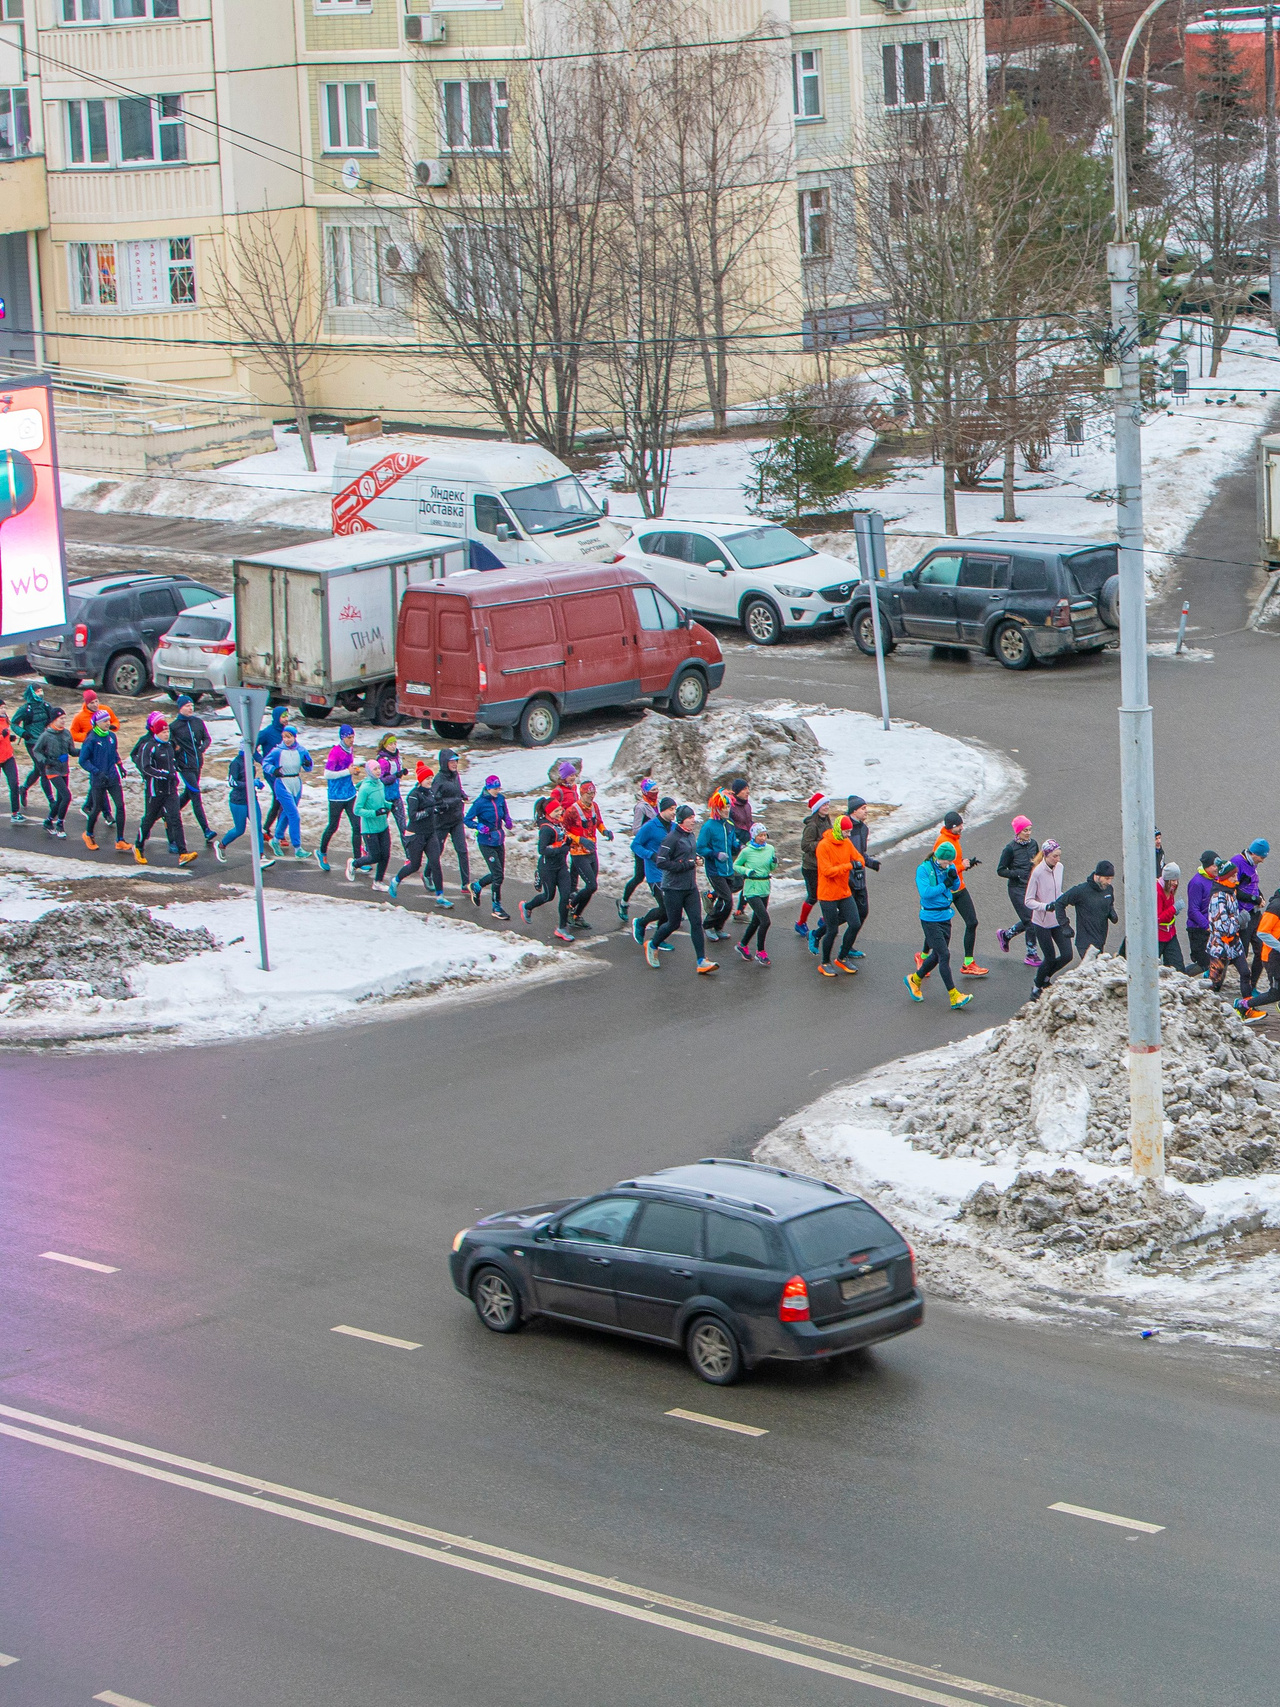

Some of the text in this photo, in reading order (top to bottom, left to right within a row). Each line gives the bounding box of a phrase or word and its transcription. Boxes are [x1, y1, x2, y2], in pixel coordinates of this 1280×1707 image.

[430, 485, 465, 502] Яндекс
[418, 499, 464, 517] Доставка
[10, 567, 49, 596] wb
